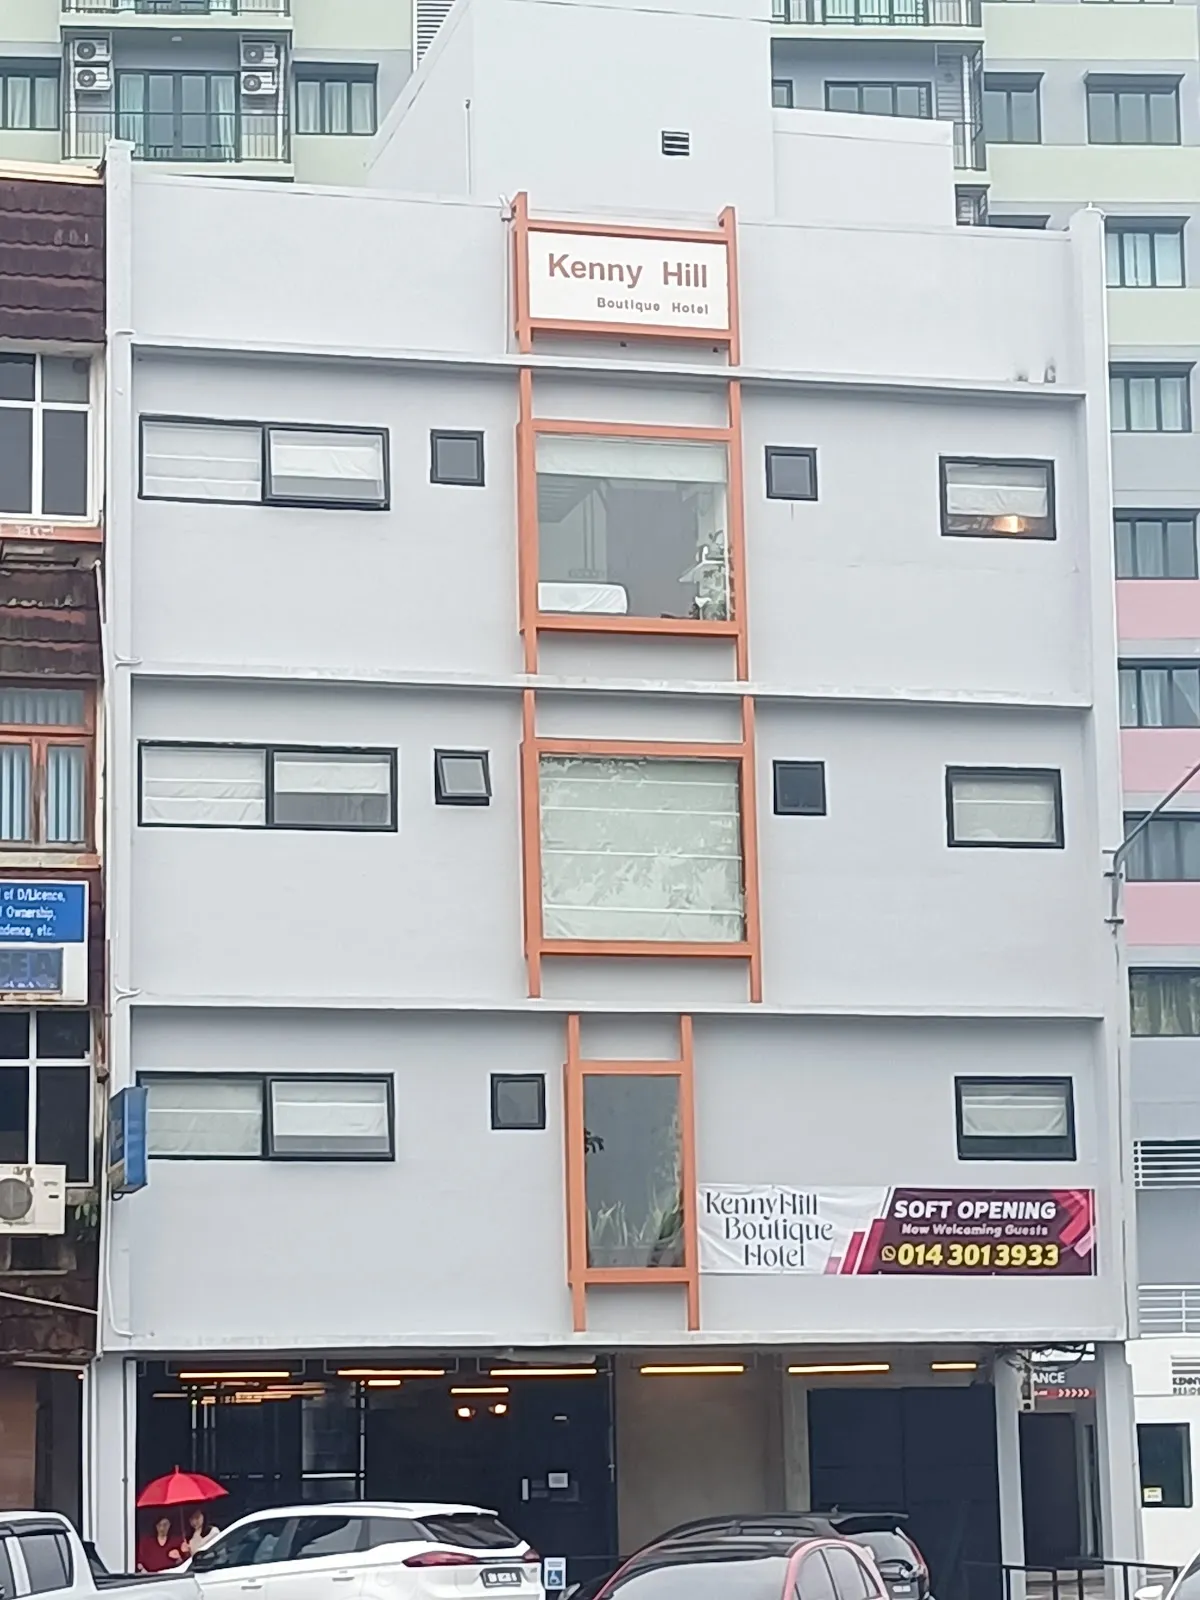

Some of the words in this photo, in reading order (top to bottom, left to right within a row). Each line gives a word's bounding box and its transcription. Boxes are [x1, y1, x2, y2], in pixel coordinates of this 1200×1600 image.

[548, 253, 643, 289] Kenny
[663, 261, 707, 288] Hill
[597, 297, 660, 313] Boutique
[672, 302, 709, 315] Hotel
[894, 1200, 953, 1219] SOFT
[957, 1201, 1057, 1220] OPENING
[725, 1216, 834, 1244] Boutique
[902, 1223, 930, 1235] Now
[932, 1223, 1002, 1238] Welcoming
[1004, 1224, 1048, 1236] Guests
[744, 1244, 805, 1266] Hotel
[898, 1243, 943, 1266] 014
[947, 1243, 991, 1266] 301
[994, 1243, 1059, 1266] 3933
[1031, 1371, 1066, 1384] ANCE
